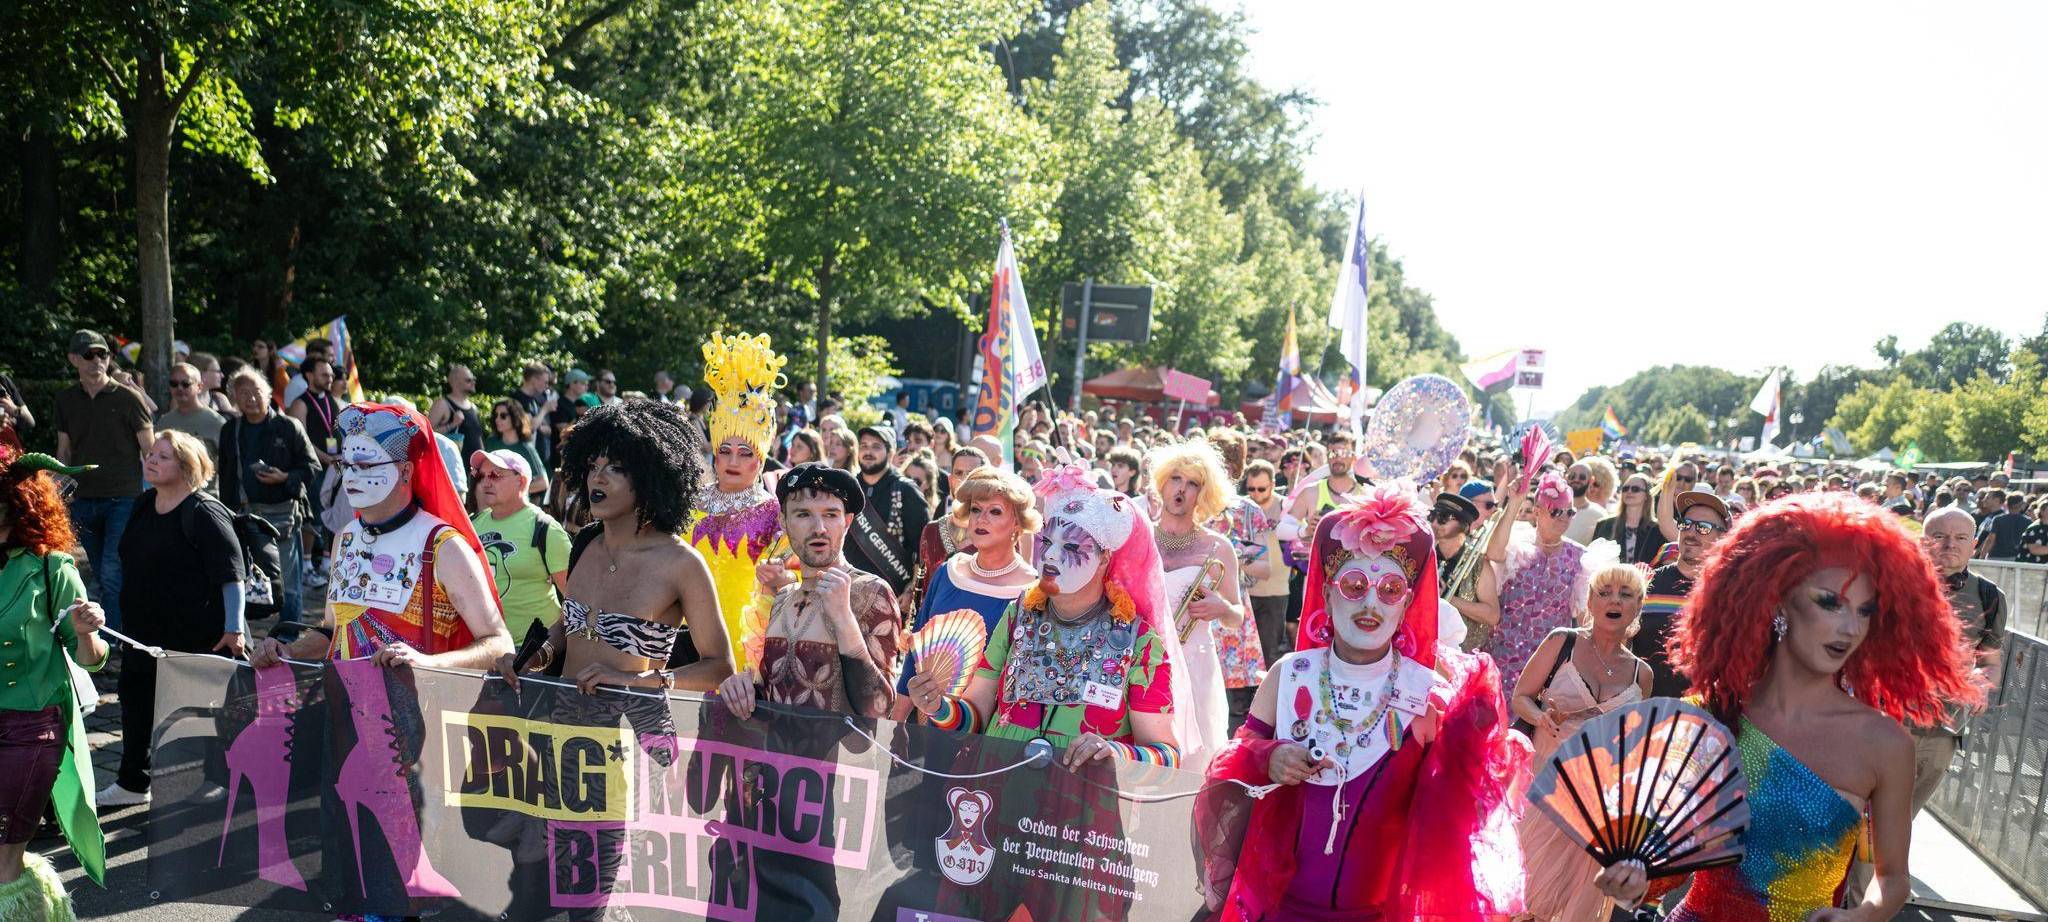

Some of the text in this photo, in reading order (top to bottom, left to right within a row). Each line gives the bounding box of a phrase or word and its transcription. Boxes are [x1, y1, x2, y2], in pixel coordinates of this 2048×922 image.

[869, 531, 910, 580] GERMANY
[648, 745, 868, 854] MARCH
[1018, 816, 1150, 858] Orden der Schwestern
[554, 828, 749, 910] BERLIN
[1003, 837, 1159, 888] der Perpetuellen Indulgenz
[1012, 863, 1144, 901] Haus Sankta Melitta Iuvenis
